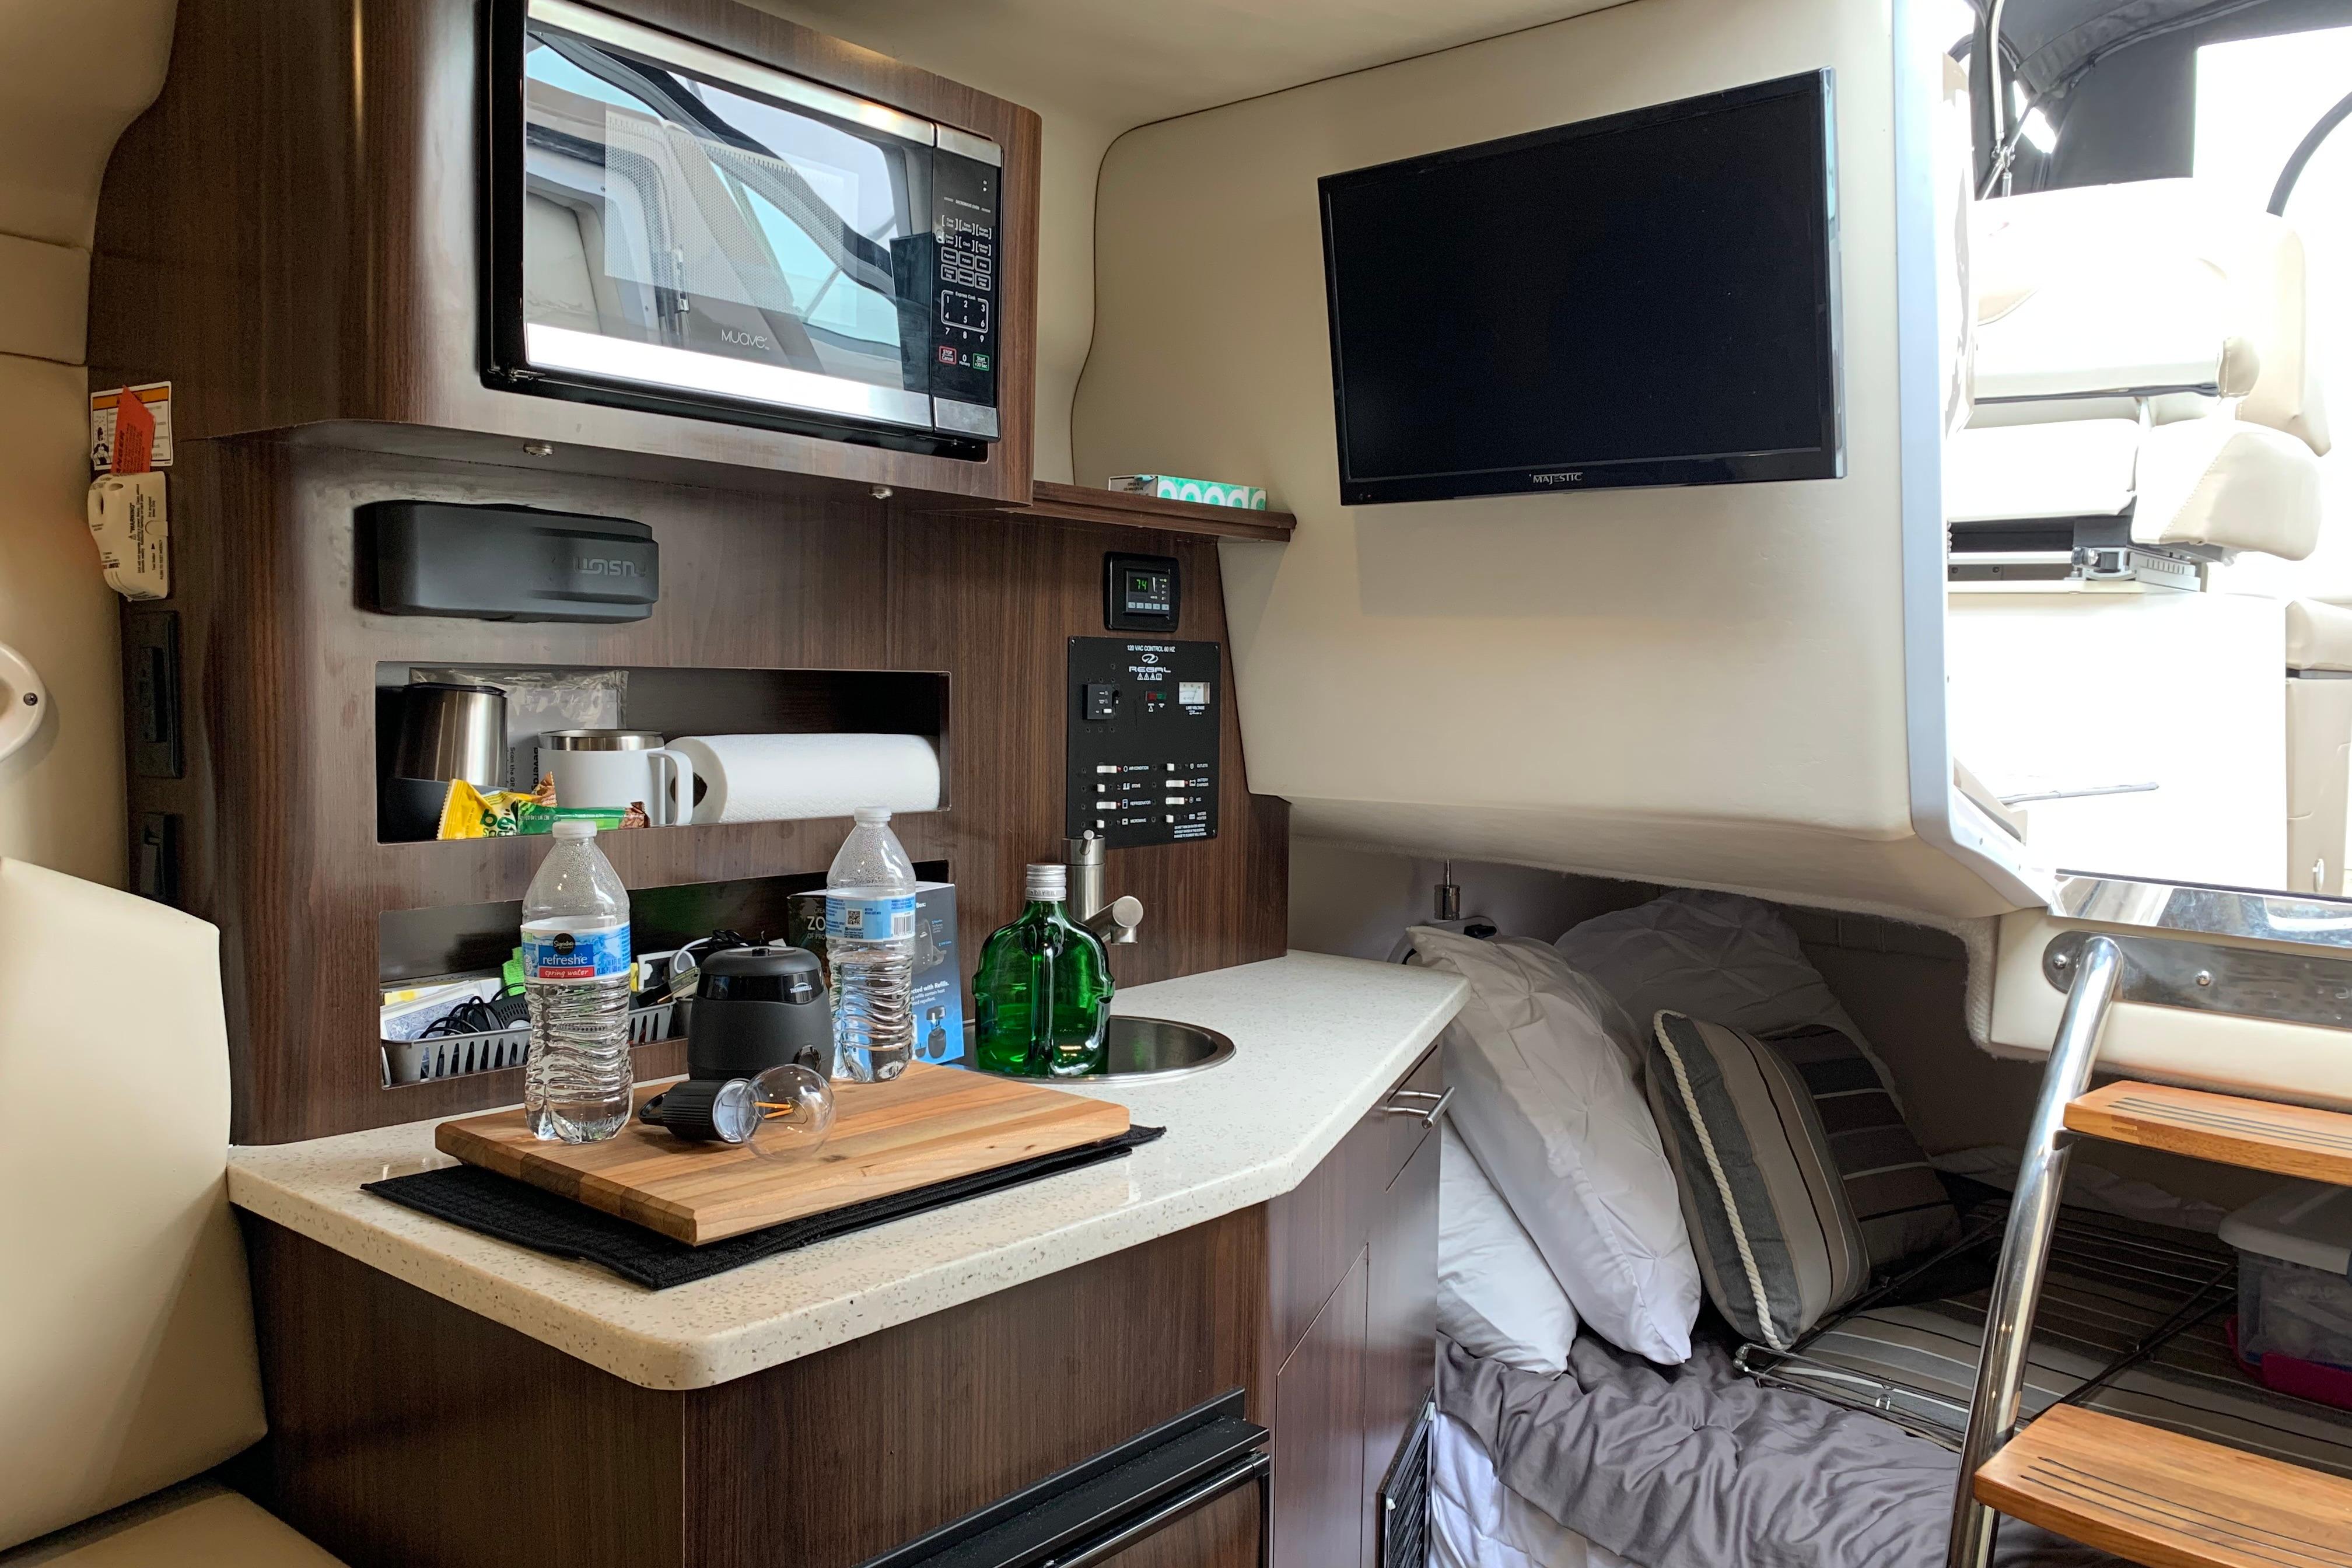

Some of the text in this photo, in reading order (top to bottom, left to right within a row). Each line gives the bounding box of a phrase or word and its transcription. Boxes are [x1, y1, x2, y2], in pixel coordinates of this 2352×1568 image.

[964, 300, 968, 308] 2
[981, 304, 985, 313] 3
[963, 315, 968, 324] 5
[981, 320, 985, 328] 6
[946, 327, 984, 343] 7 8 9
[962, 354, 967, 362] 0
[1533, 472, 1583, 485] MAJESTIC
[1136, 579, 1147, 590] 74
[510, 777, 516, 787] QR
[807, 916, 826, 931] ZO
[545, 969, 566, 978] spring
